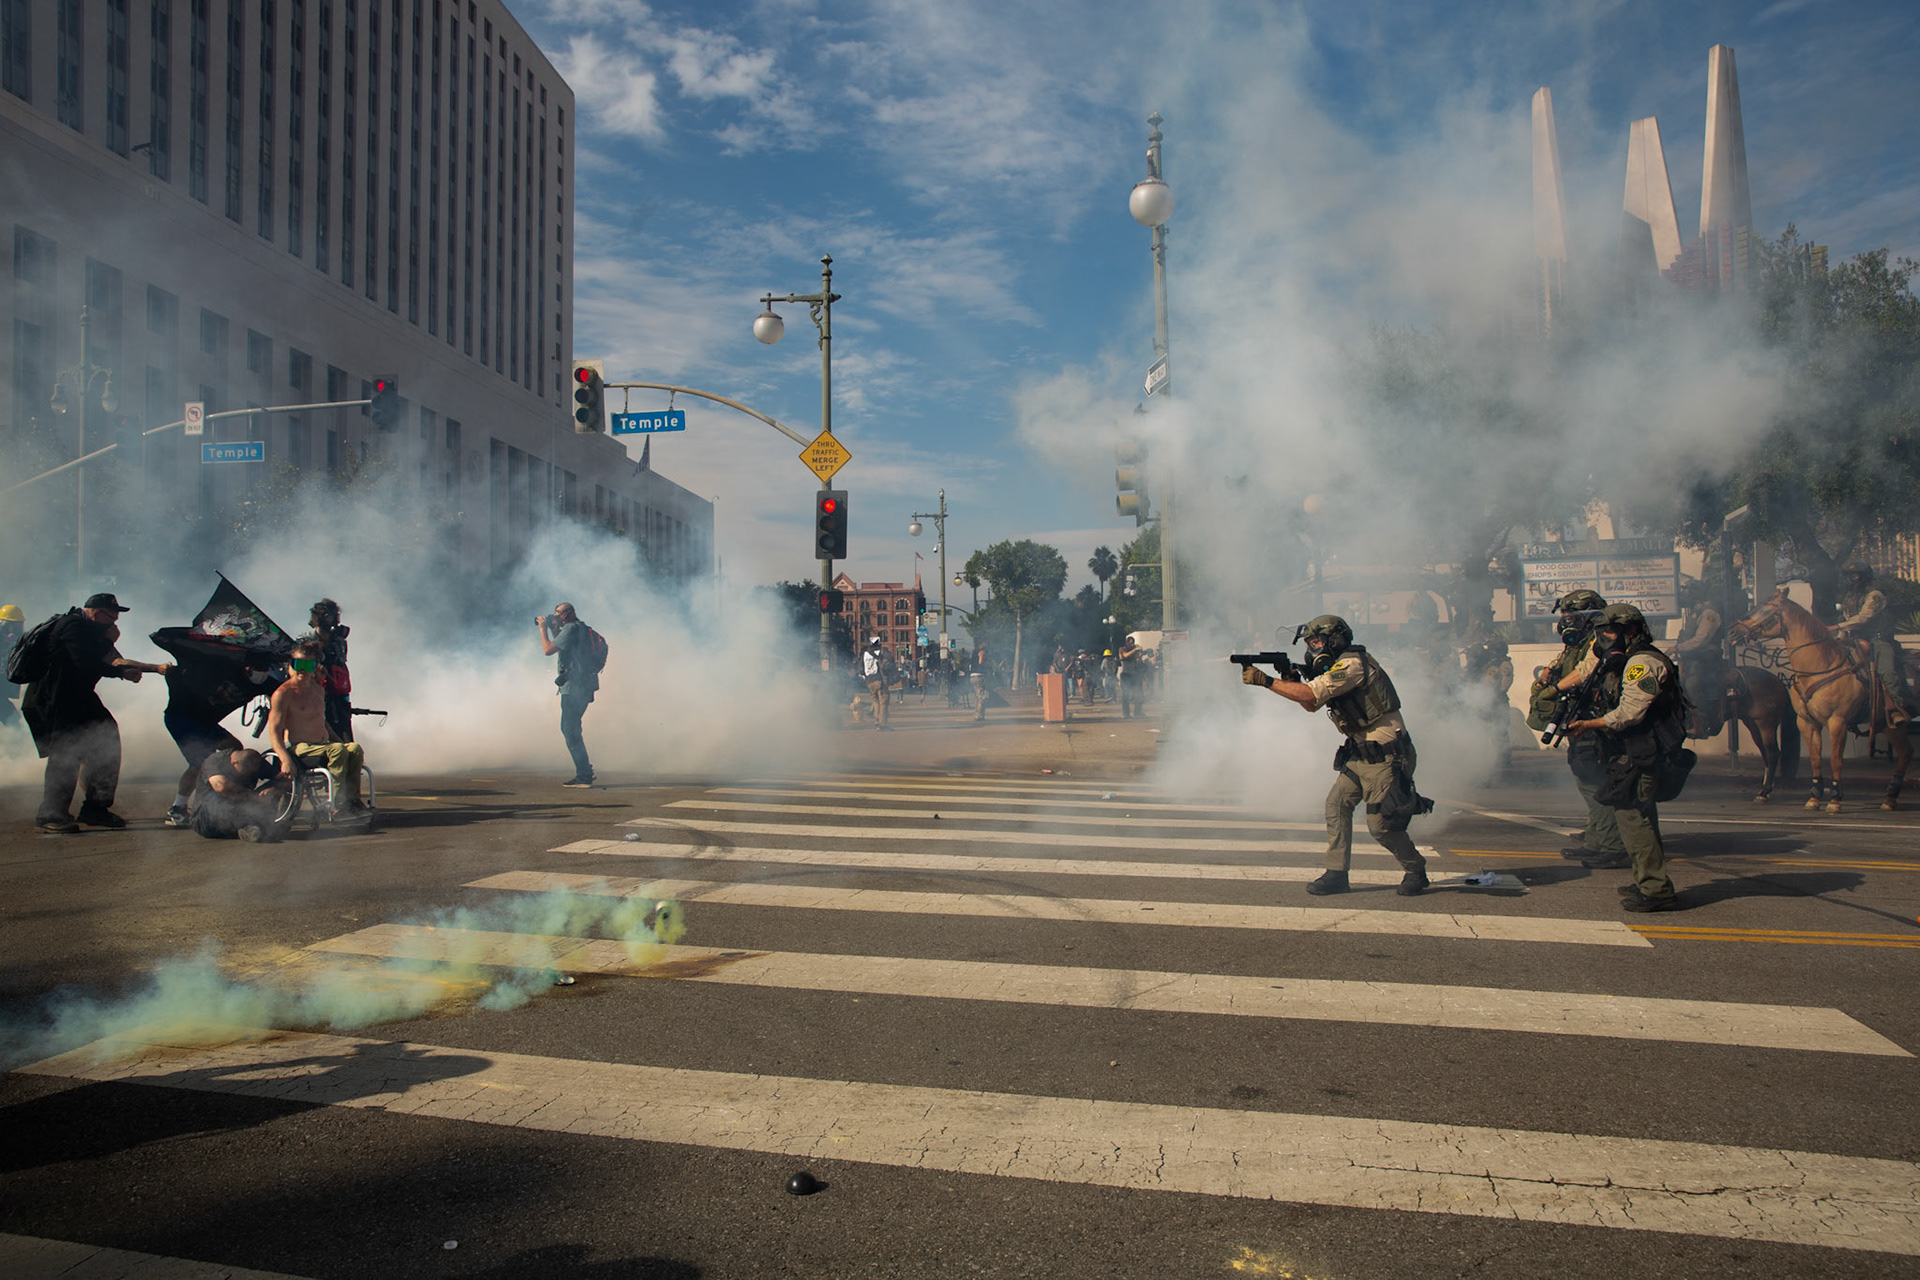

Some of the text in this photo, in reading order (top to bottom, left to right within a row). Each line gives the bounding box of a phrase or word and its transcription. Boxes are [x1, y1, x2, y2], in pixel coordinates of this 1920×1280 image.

[620, 415, 678, 430] Temple
[208, 447, 257, 459] Temple
[1529, 581, 1587, 597] FUCK ICE
[1635, 599, 1666, 612] ICE
